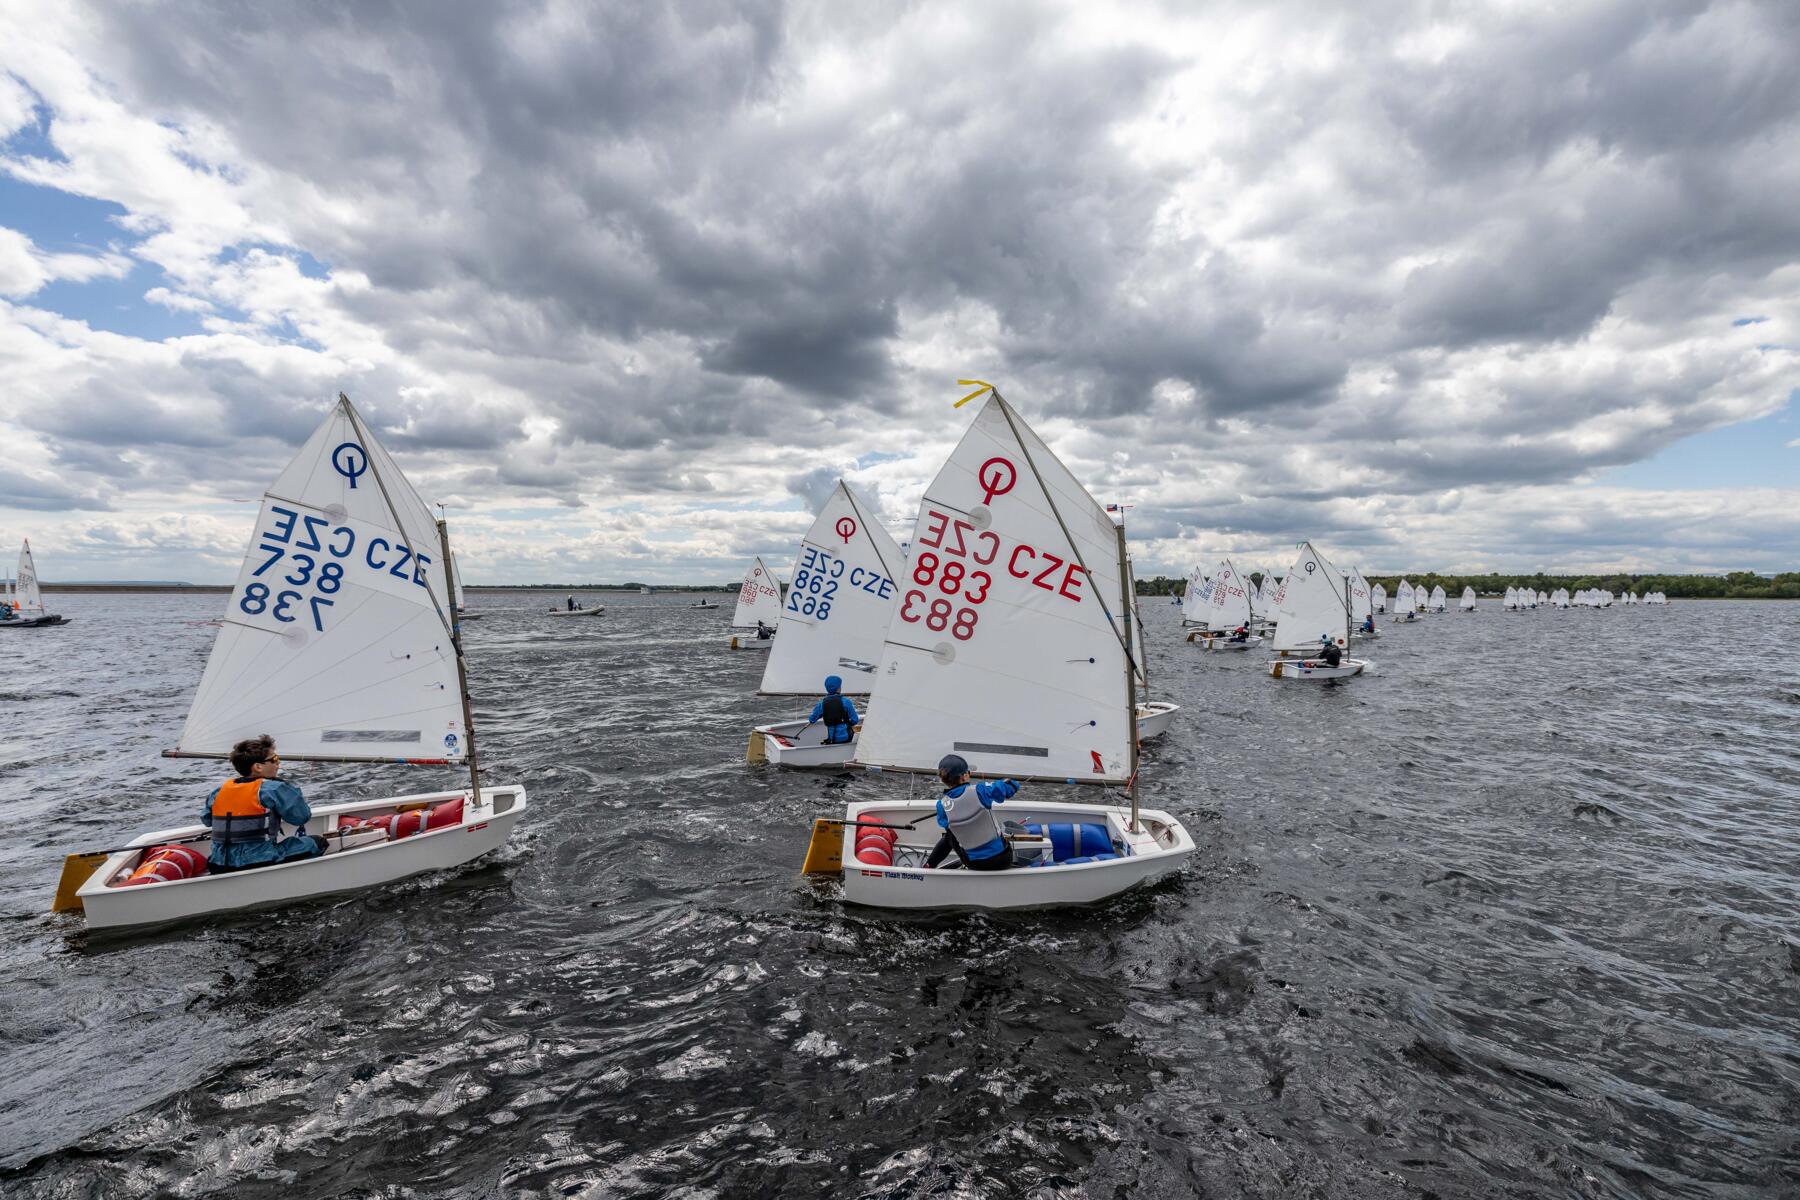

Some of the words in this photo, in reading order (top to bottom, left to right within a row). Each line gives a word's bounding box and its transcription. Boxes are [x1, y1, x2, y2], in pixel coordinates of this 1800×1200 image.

[252, 543, 344, 594] 738
[366, 538, 432, 589] CZE
[913, 552, 992, 604] 883
[1008, 544, 1092, 603] CZE
[742, 586, 758, 598] 960
[760, 585, 776, 597] CZE
[795, 570, 838, 601] 862
[850, 567, 894, 600] CZE
[1228, 586, 1244, 598] CZE
